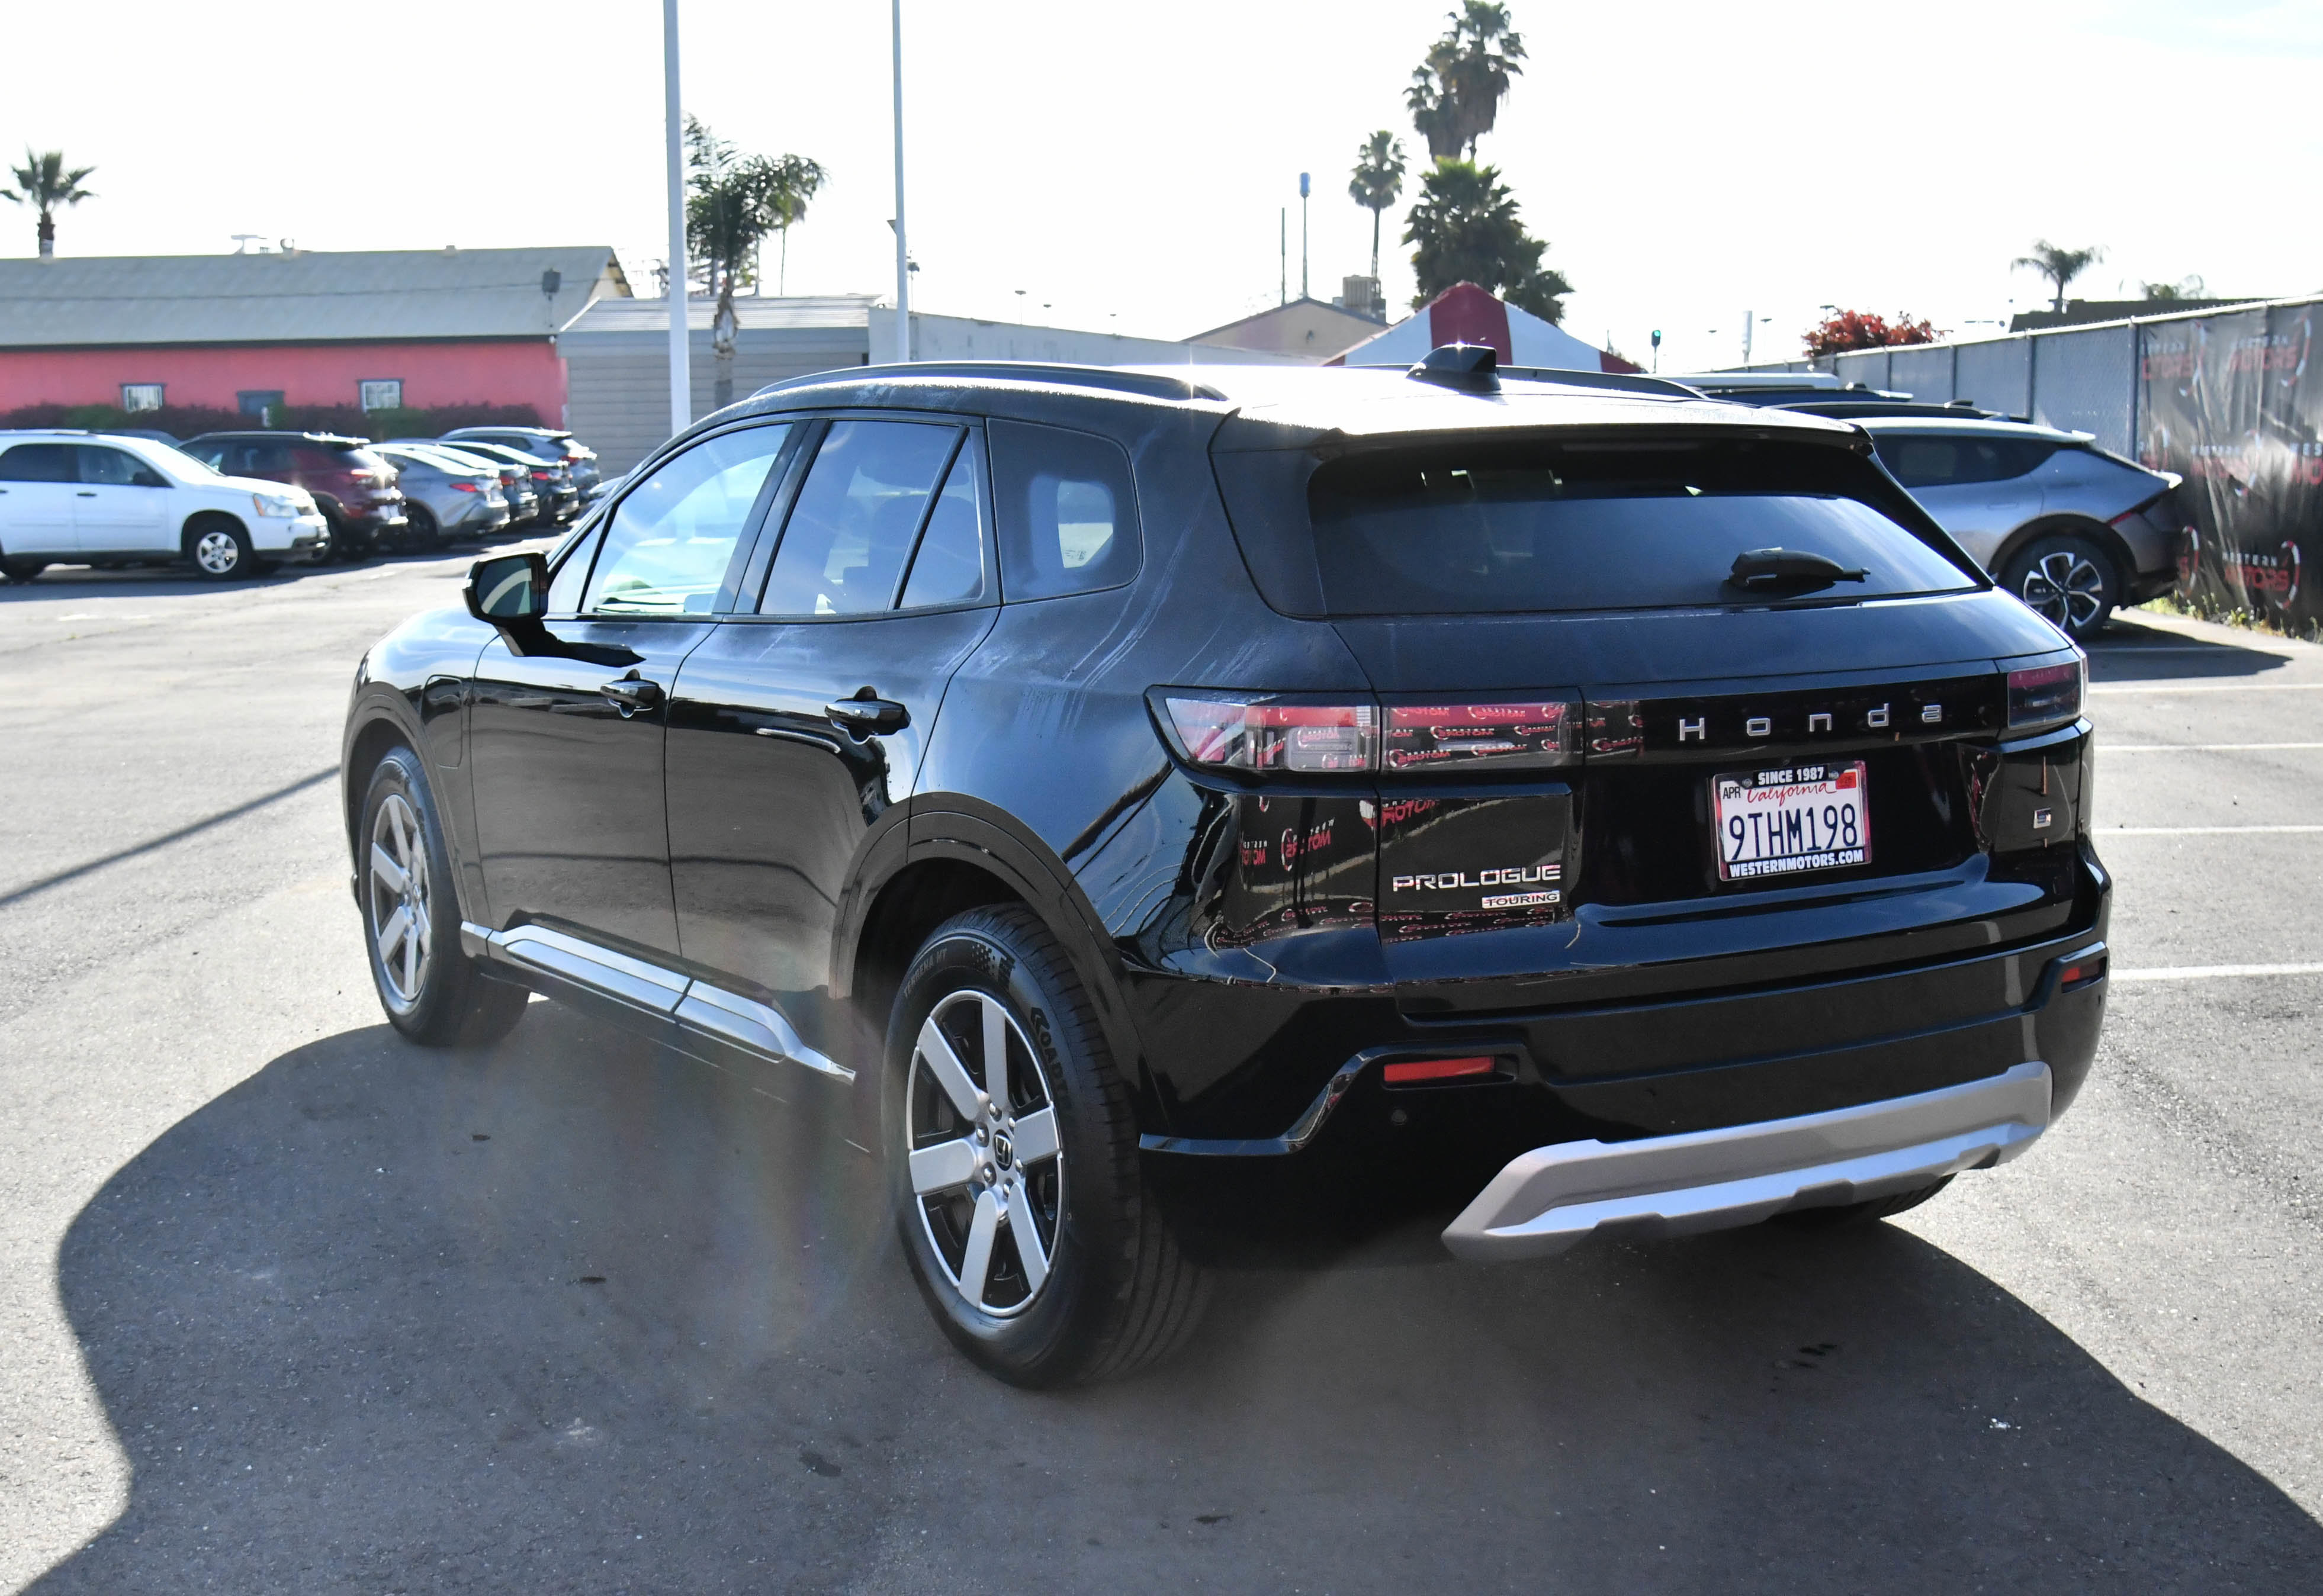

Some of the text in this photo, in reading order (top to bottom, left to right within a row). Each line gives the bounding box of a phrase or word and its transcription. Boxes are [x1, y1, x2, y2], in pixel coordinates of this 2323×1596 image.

[1757, 767, 1824, 786] SINCE 1987
[1723, 786, 1741, 799] APR
[1747, 782, 1837, 807] California
[1729, 803, 1858, 861] 9THM198
[1729, 849, 1863, 877] WESTERNMOTORS.COM
[1393, 865, 1561, 892] PROLOGUE
[1487, 893, 1558, 906] TOURING
